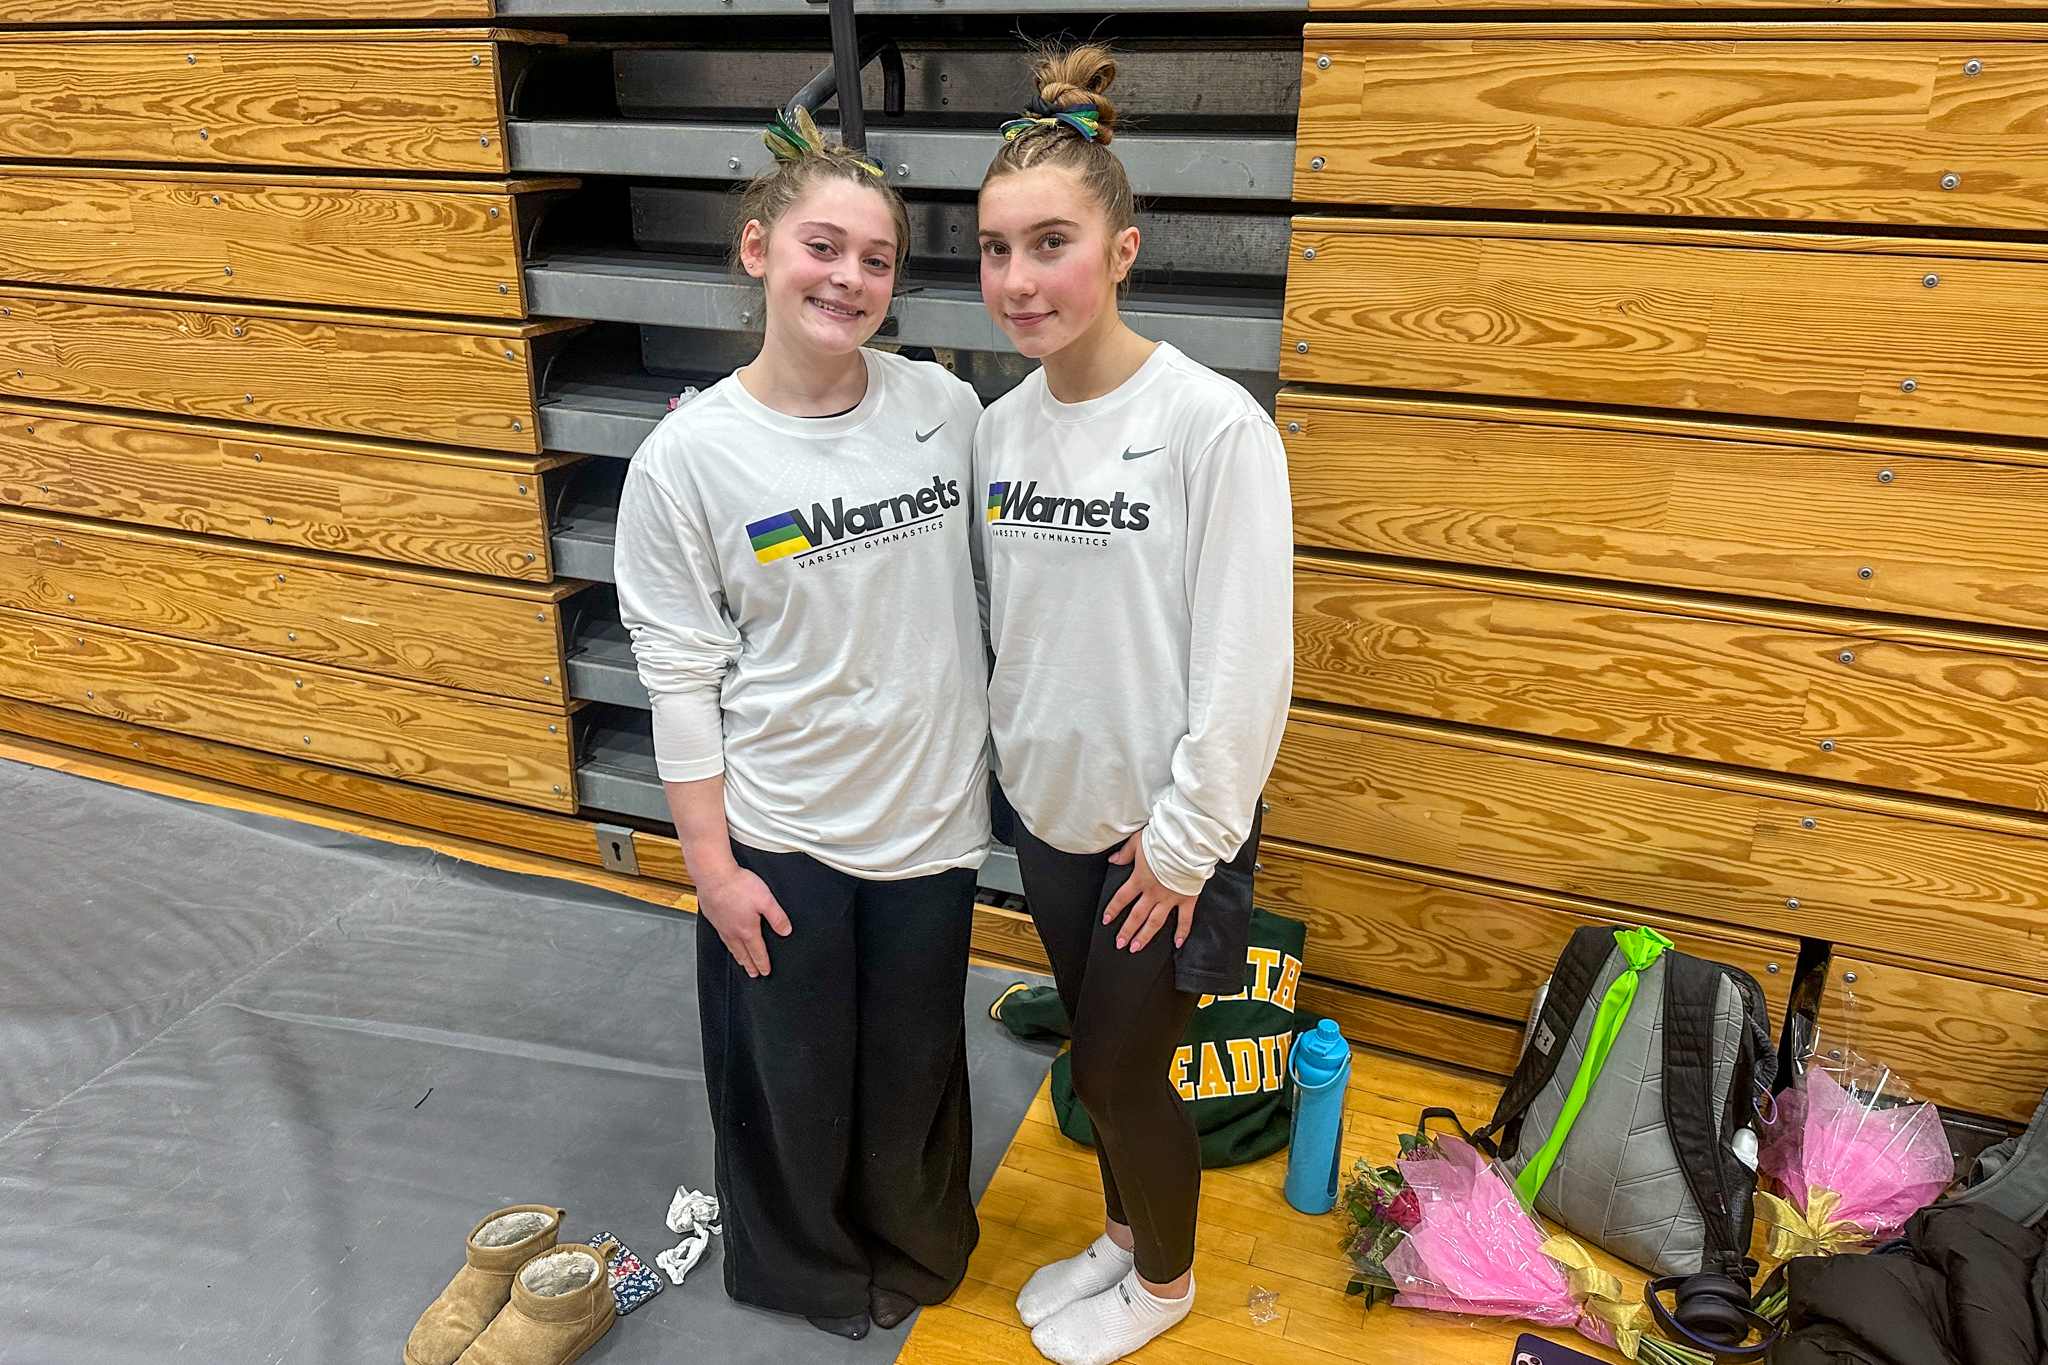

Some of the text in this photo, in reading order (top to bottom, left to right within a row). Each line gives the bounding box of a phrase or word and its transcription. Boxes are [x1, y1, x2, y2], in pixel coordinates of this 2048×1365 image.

[789, 475, 961, 548] Warnets
[1000, 480, 1151, 531] Warnets
[798, 521, 944, 569] VARSITY GYMNASTICS
[1033, 532, 1108, 547] GYMNASTICS
